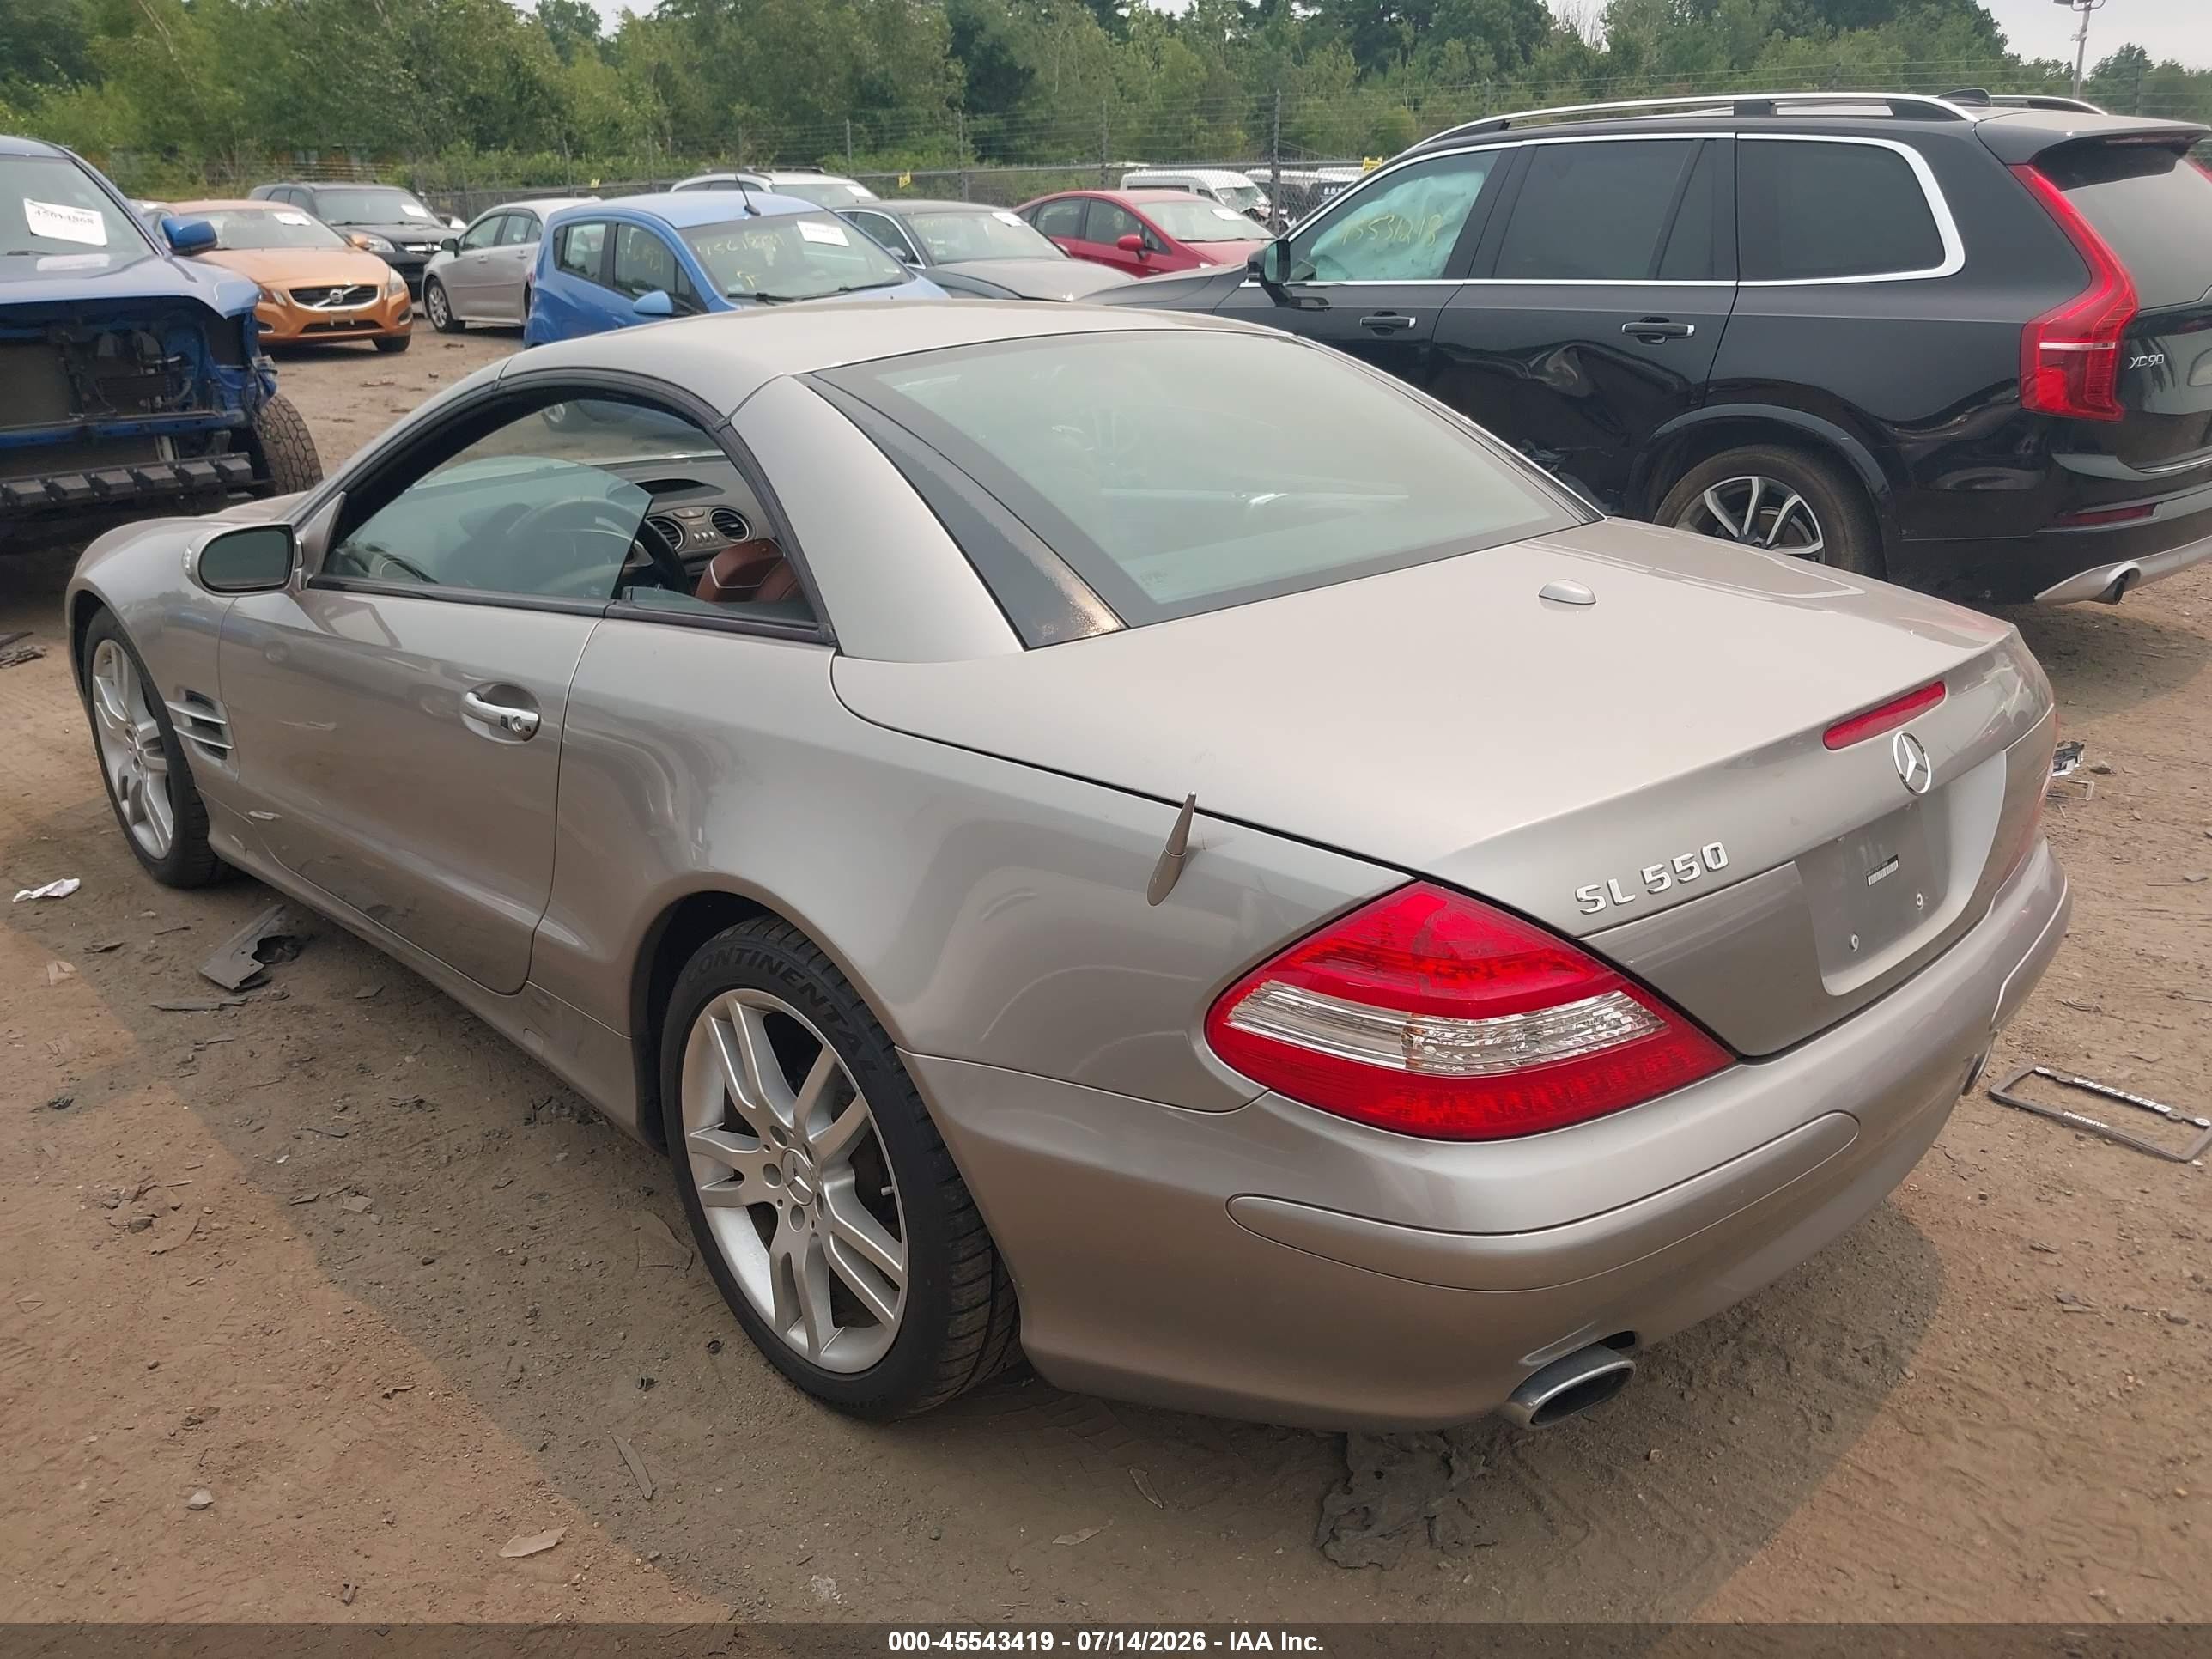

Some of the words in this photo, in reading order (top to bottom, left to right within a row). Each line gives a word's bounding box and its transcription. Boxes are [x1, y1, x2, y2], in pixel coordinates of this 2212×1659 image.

[2128, 354, 2165, 370] XC90
[1575, 878, 1636, 915] SL
[1640, 842, 1729, 895] 550
[688, 947, 878, 1073] CONTINENTAL
[2074, 1077, 2172, 1113] BERTERA
[2063, 1111, 2110, 1128] AUBURN
